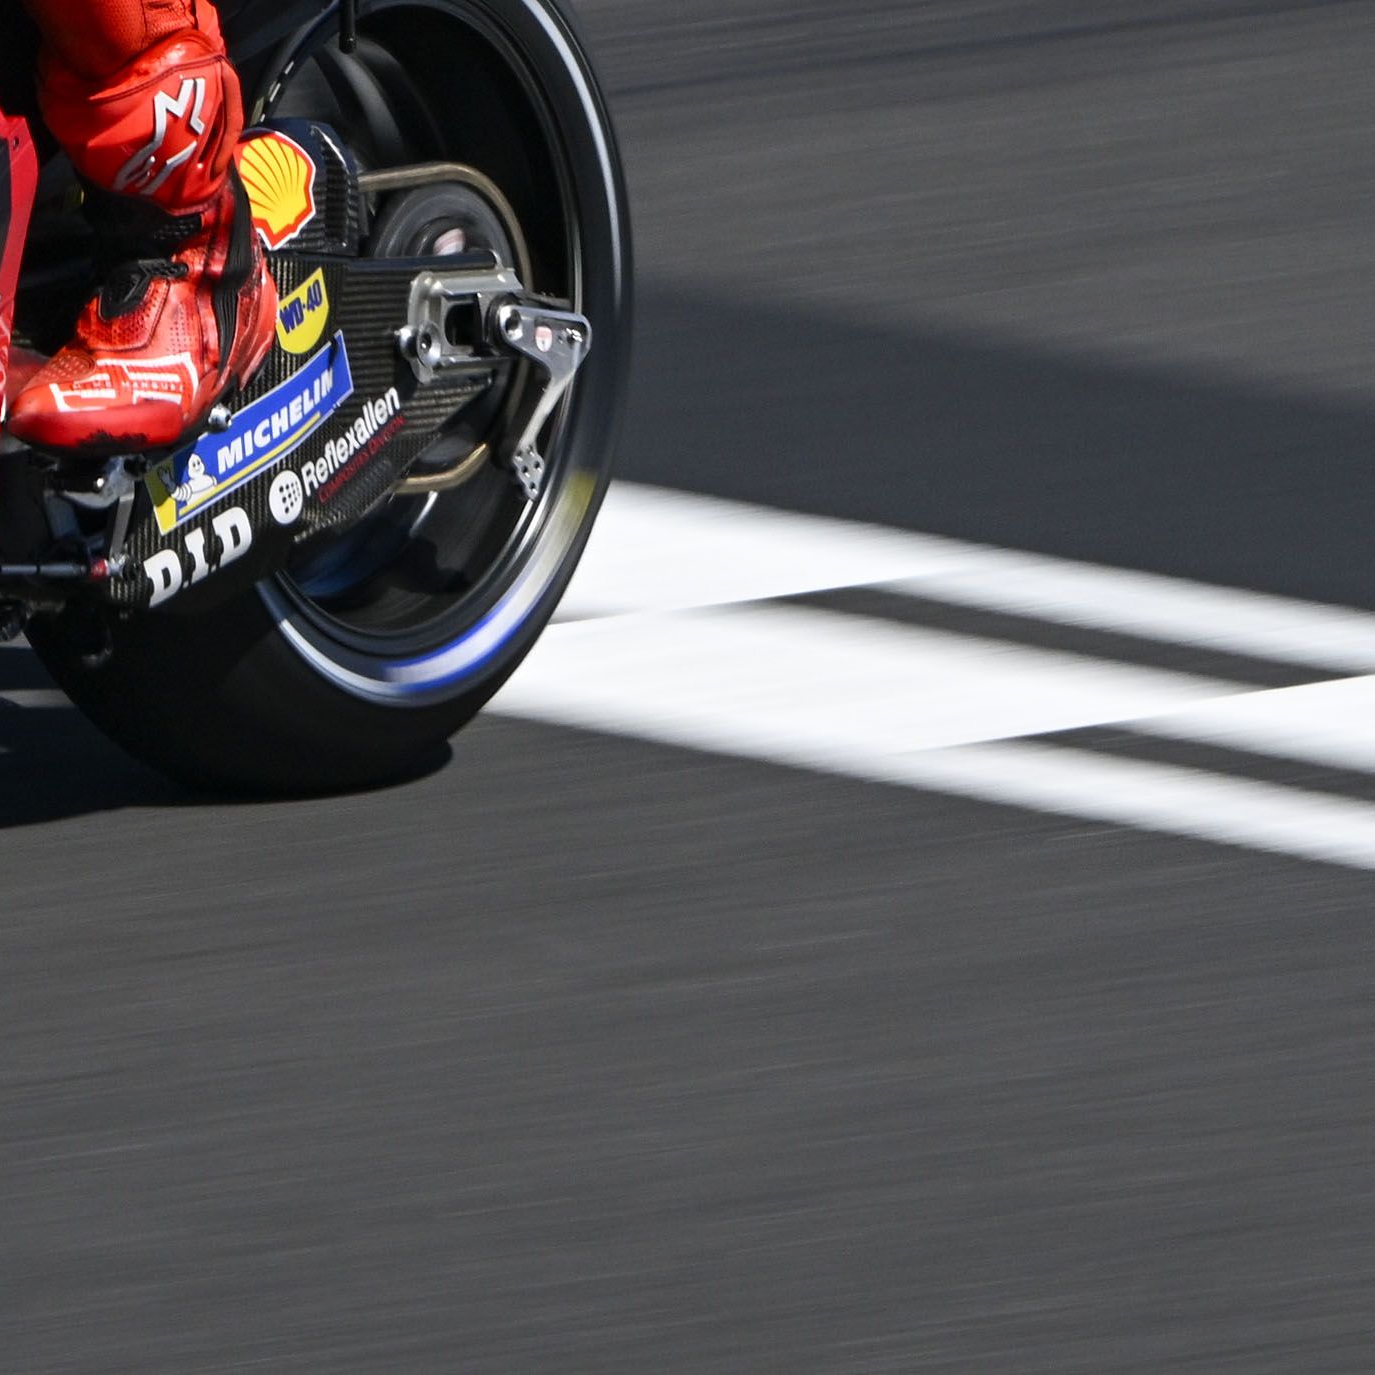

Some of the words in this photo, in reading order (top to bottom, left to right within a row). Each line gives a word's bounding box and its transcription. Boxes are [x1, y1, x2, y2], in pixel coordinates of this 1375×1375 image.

[278, 278, 324, 334] WD-40
[216, 367, 335, 473] MICHELIN
[301, 386, 401, 497] Reflexallen
